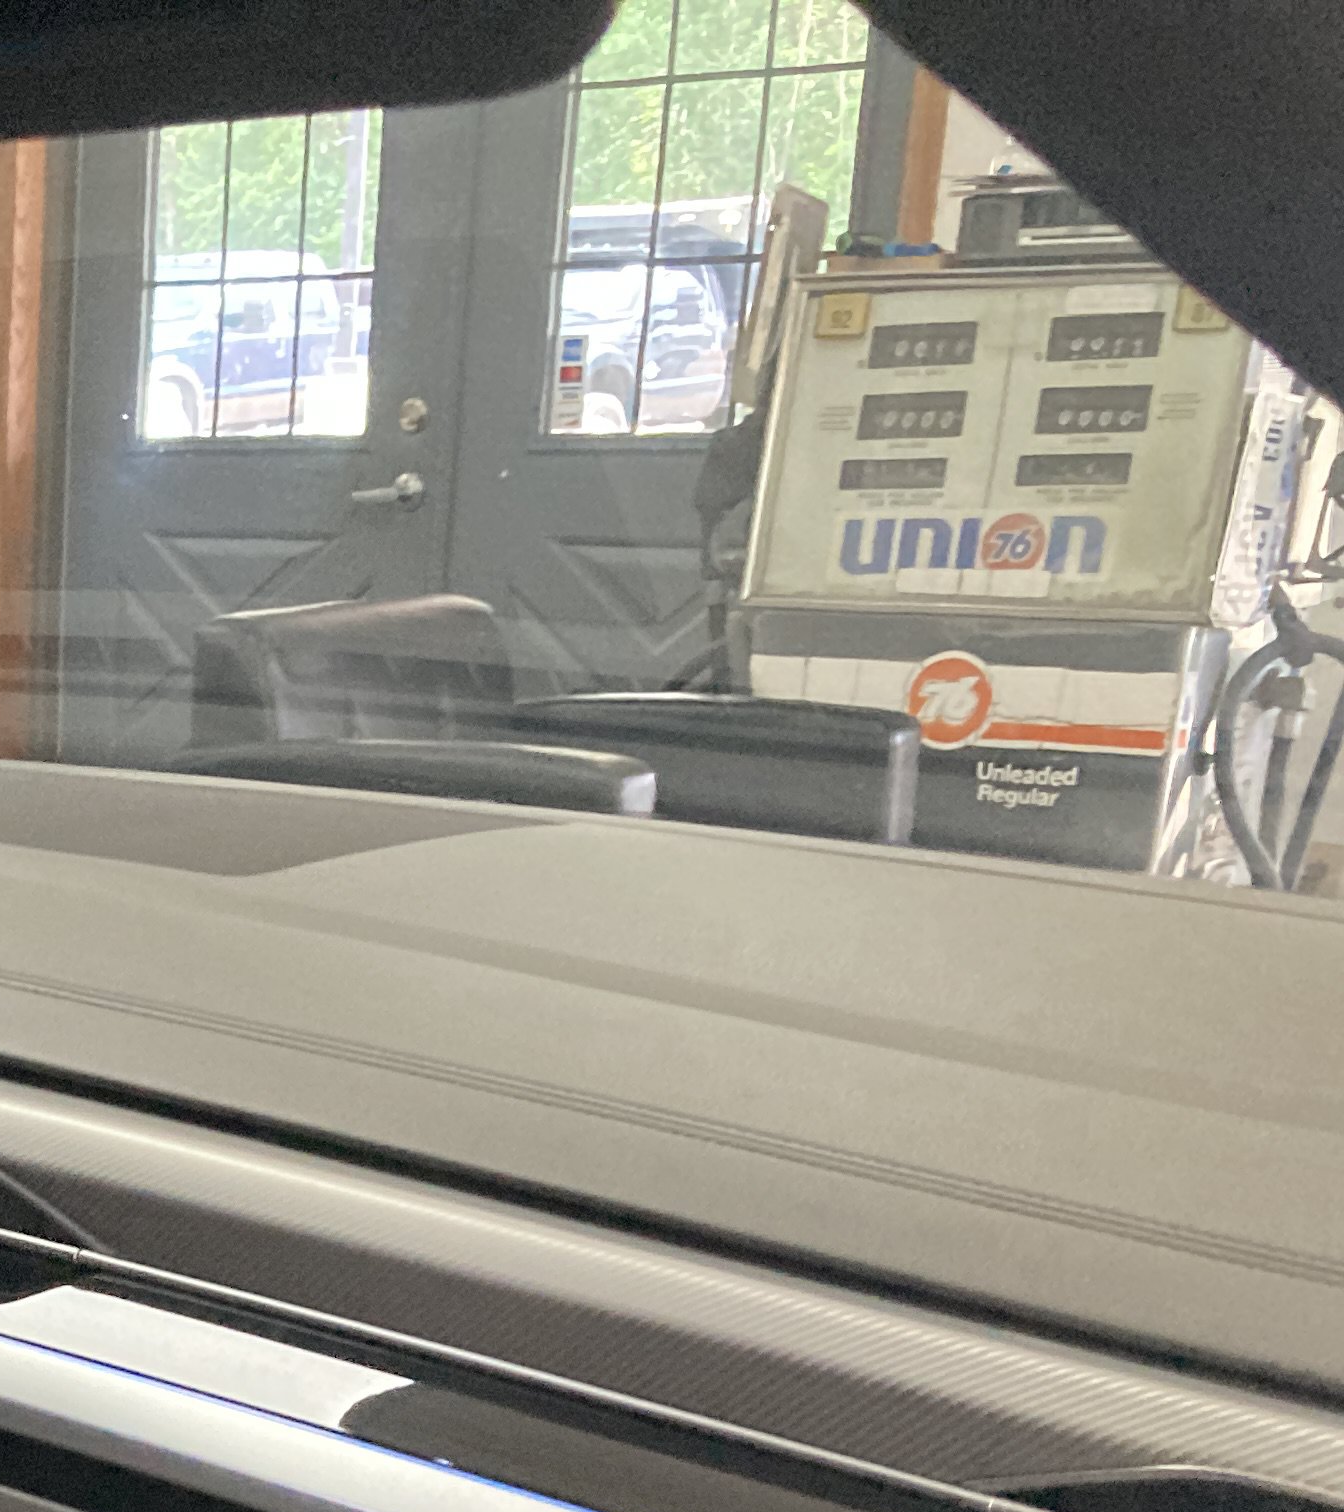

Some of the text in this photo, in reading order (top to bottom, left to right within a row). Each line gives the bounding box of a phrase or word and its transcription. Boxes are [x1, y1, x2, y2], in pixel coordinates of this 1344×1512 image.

[916, 675, 981, 727] 76
[975, 761, 1079, 787] Unleaded
[975, 784, 1062, 809] Regular
